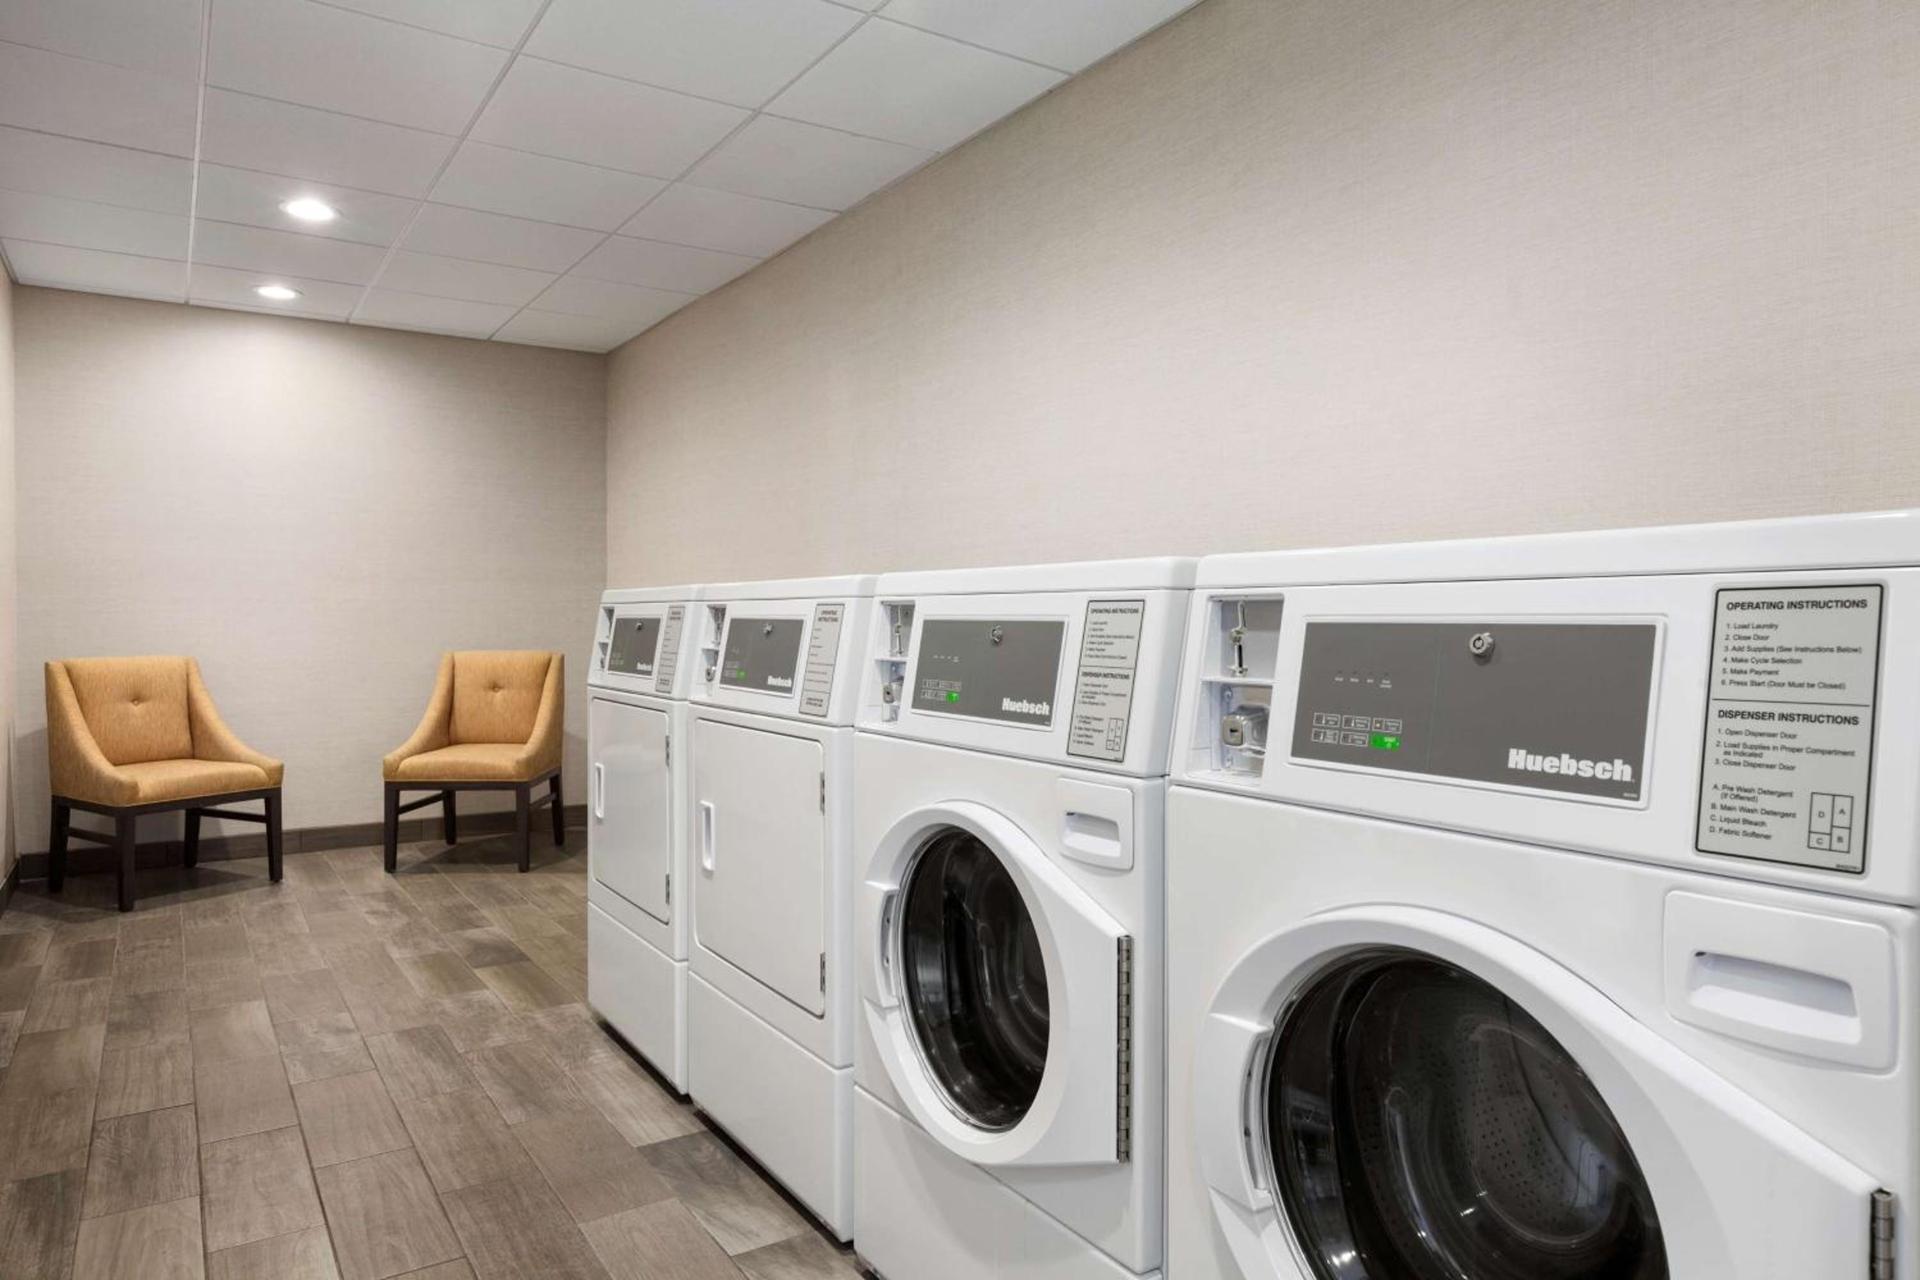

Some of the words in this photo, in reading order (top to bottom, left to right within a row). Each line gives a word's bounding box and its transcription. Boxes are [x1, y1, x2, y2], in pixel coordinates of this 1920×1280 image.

[1726, 600, 1784, 611] OPERATING
[1787, 599, 1868, 609] INSTRUCTIONS
[1836, 646, 1861, 654] Below)
[1751, 657, 1769, 665] Cycle
[1817, 682, 1845, 690] Closed)
[1002, 698, 1049, 715] Huebsch
[1718, 709, 1775, 721] DISPENSER
[1778, 712, 1860, 725] INSTRUCTIONS
[1725, 728, 1743, 736] Open
[1744, 729, 1778, 739] Dispenser
[1780, 731, 1797, 739] Door
[1732, 750, 1763, 758] Indicated
[1742, 742, 1770, 751] Supplies
[1780, 745, 1803, 753] Proper
[1805, 747, 1855, 757] Compartment
[1508, 748, 1632, 782] Huebsch
[1722, 759, 1741, 767] Close
[1743, 760, 1776, 769] Dispenser
[1721, 784, 1734, 792] Pre
[1757, 788, 1793, 798] Detergent
[1730, 793, 1758, 802] Offered)
[1720, 804, 1737, 812] Main
[1760, 807, 1797, 818] Detergent
[1719, 816, 1741, 824] Liquid
[1743, 818, 1767, 827] Bleach
[1718, 827, 1740, 836] Fabric
[1742, 829, 1772, 840] Softener
